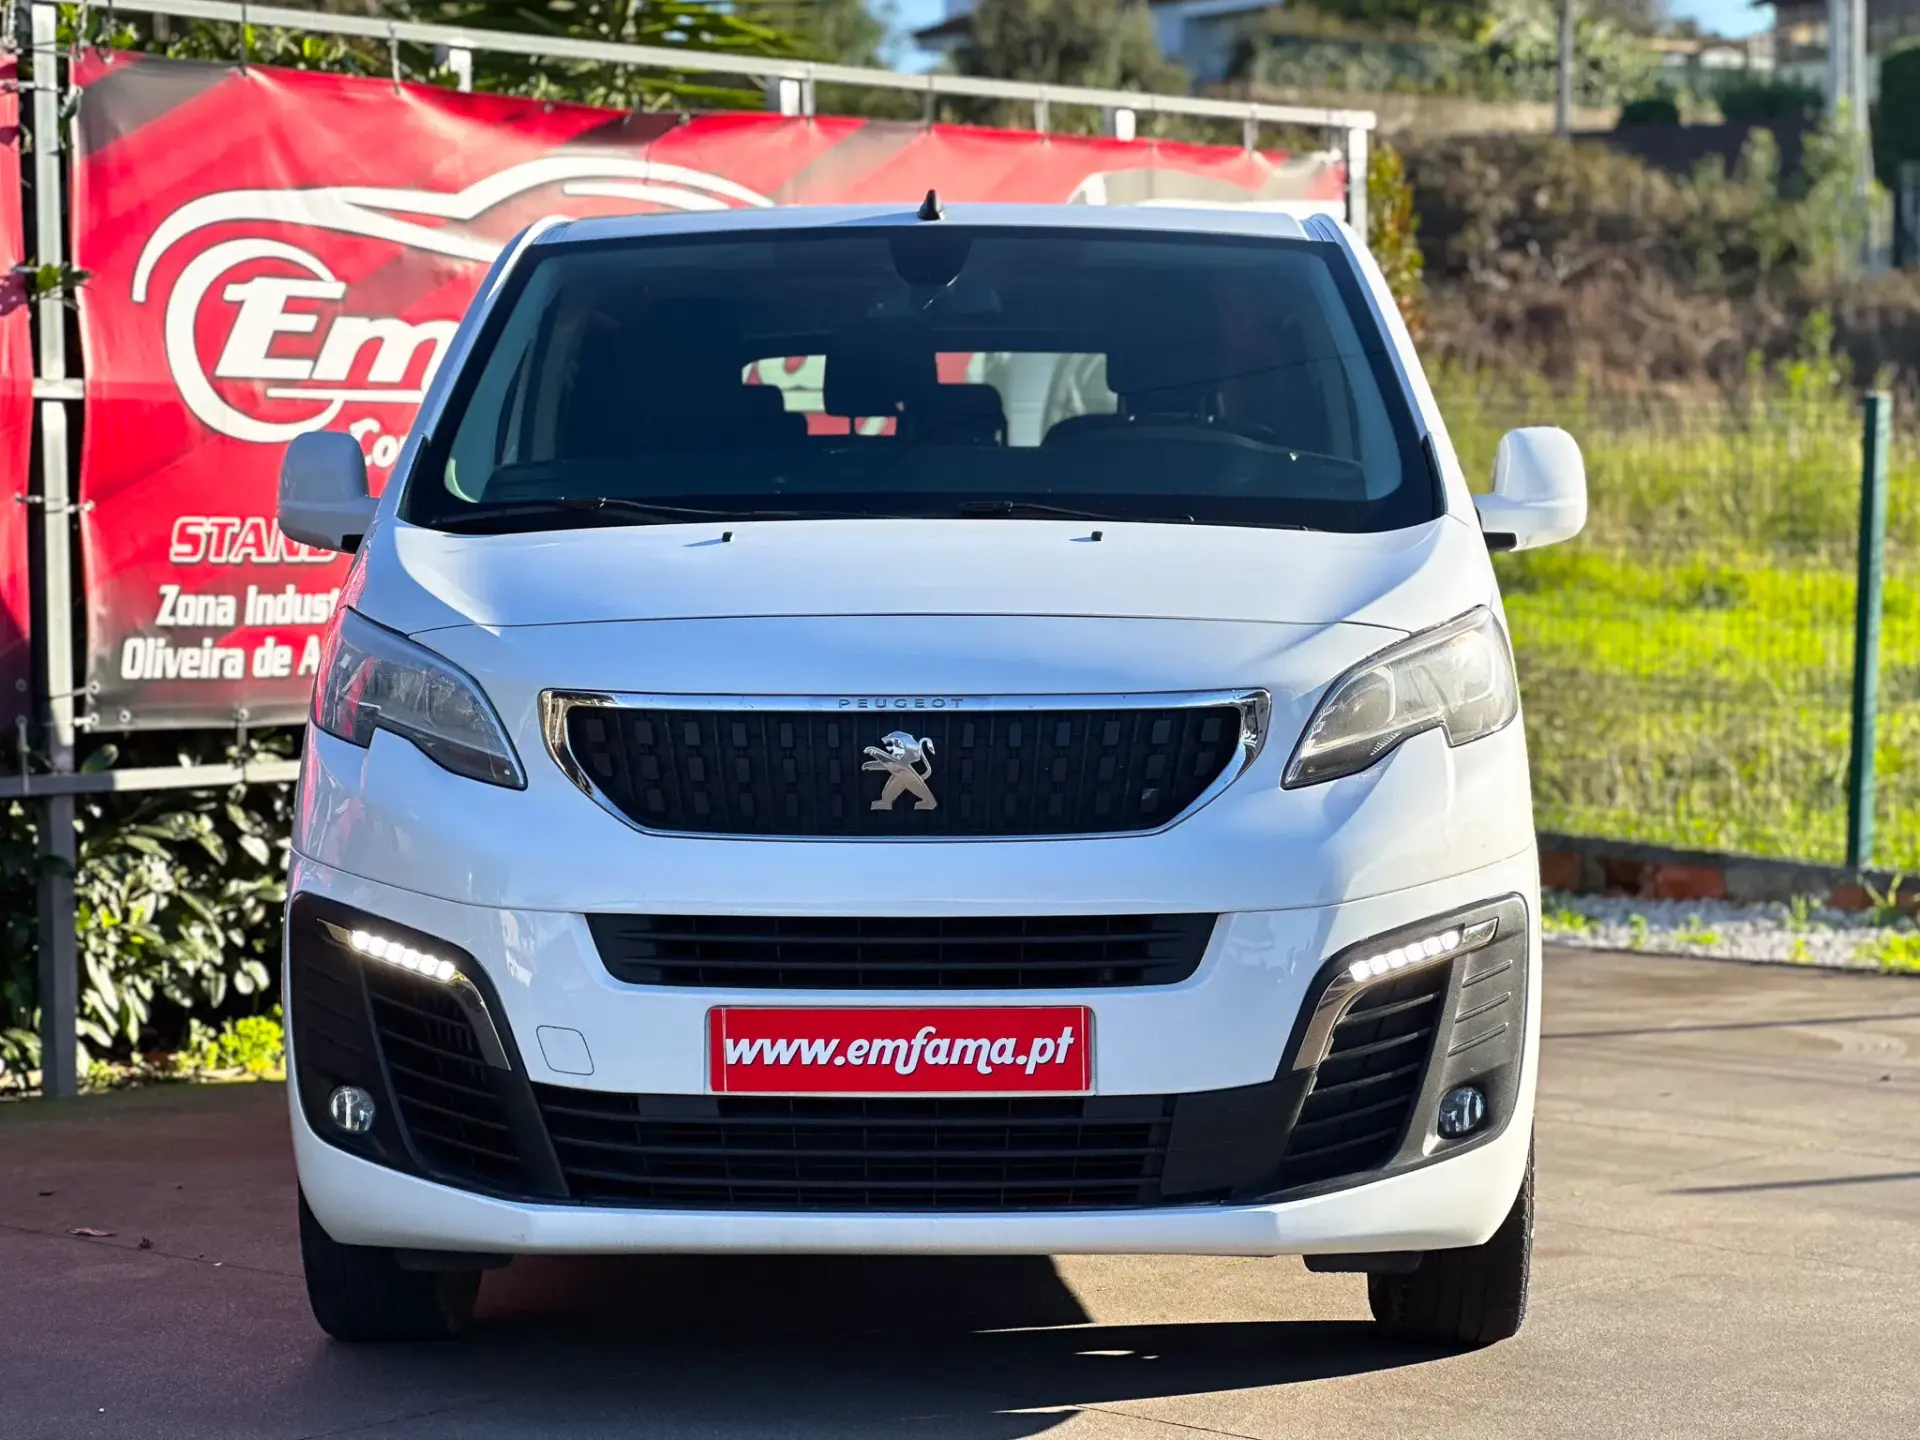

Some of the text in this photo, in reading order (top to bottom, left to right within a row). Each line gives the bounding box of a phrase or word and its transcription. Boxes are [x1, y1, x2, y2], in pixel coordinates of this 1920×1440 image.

[155, 584, 236, 626] Zona
[121, 636, 245, 680] Oliveira
[252, 636, 292, 677] de
[838, 698, 964, 709] PEUGEOT
[725, 1026, 1075, 1075] www.emfama.pt
